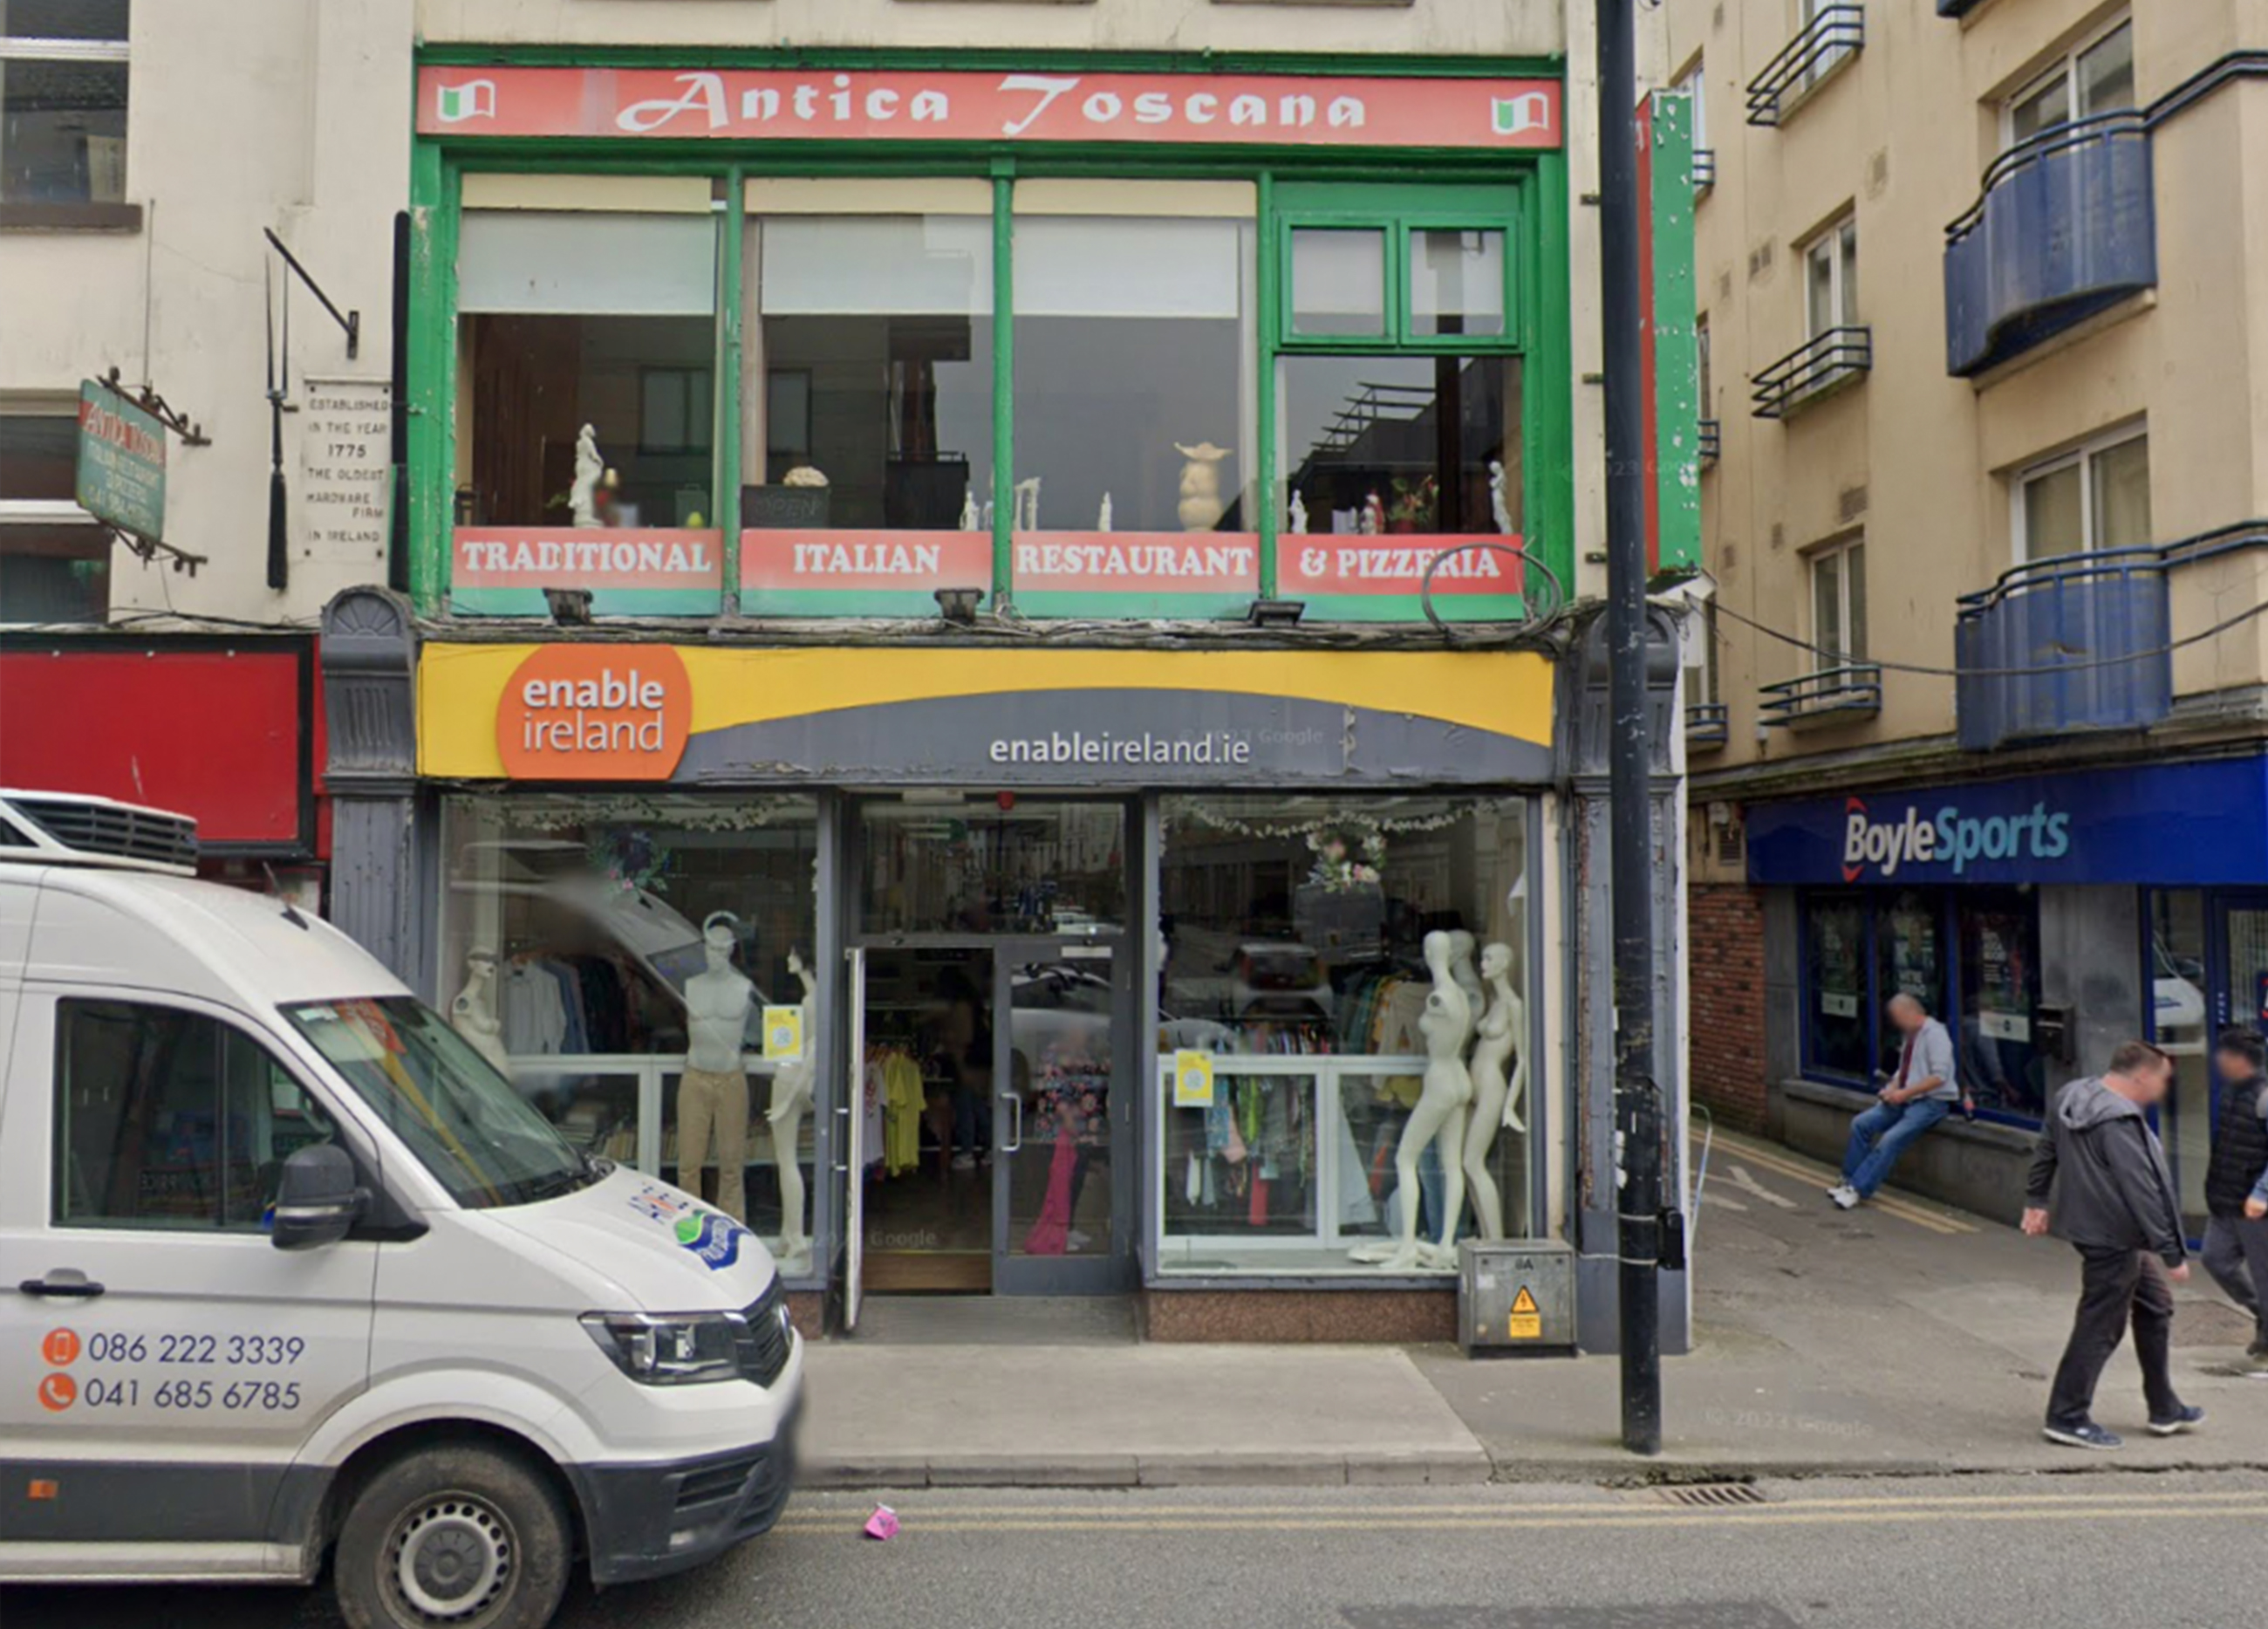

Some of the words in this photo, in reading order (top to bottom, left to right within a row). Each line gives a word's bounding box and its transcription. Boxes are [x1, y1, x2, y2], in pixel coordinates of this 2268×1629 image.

[616, 72, 949, 132] Antica
[998, 75, 1366, 136] Toscana
[309, 398, 389, 411] ESTABLISHED
[327, 422, 351, 435] THE
[357, 423, 387, 435] YEAR
[328, 443, 367, 458] 1775
[308, 468, 331, 480] THE
[338, 469, 385, 481] OLDEST
[306, 492, 371, 504] HARDWARE
[352, 507, 384, 519] FIRM
[327, 530, 380, 543] IRELAND
[461, 542, 713, 572] TRADITIONAL
[793, 544, 942, 574] ITALIAN
[1017, 545, 1254, 577] RESTAURANT
[1299, 548, 1327, 578] &
[1336, 547, 1501, 578] PIZZERIA
[522, 668, 665, 709] enable
[523, 710, 664, 751] ireland
[989, 731, 1250, 764] enableireland.ie
[1843, 800, 2070, 876] BoyleSports
[88, 1332, 147, 1363] 086
[158, 1334, 217, 1364] 222
[226, 1335, 305, 1365] 3339
[85, 1378, 139, 1407] 041
[154, 1379, 213, 1408] 685
[222, 1381, 302, 1410] 6785
